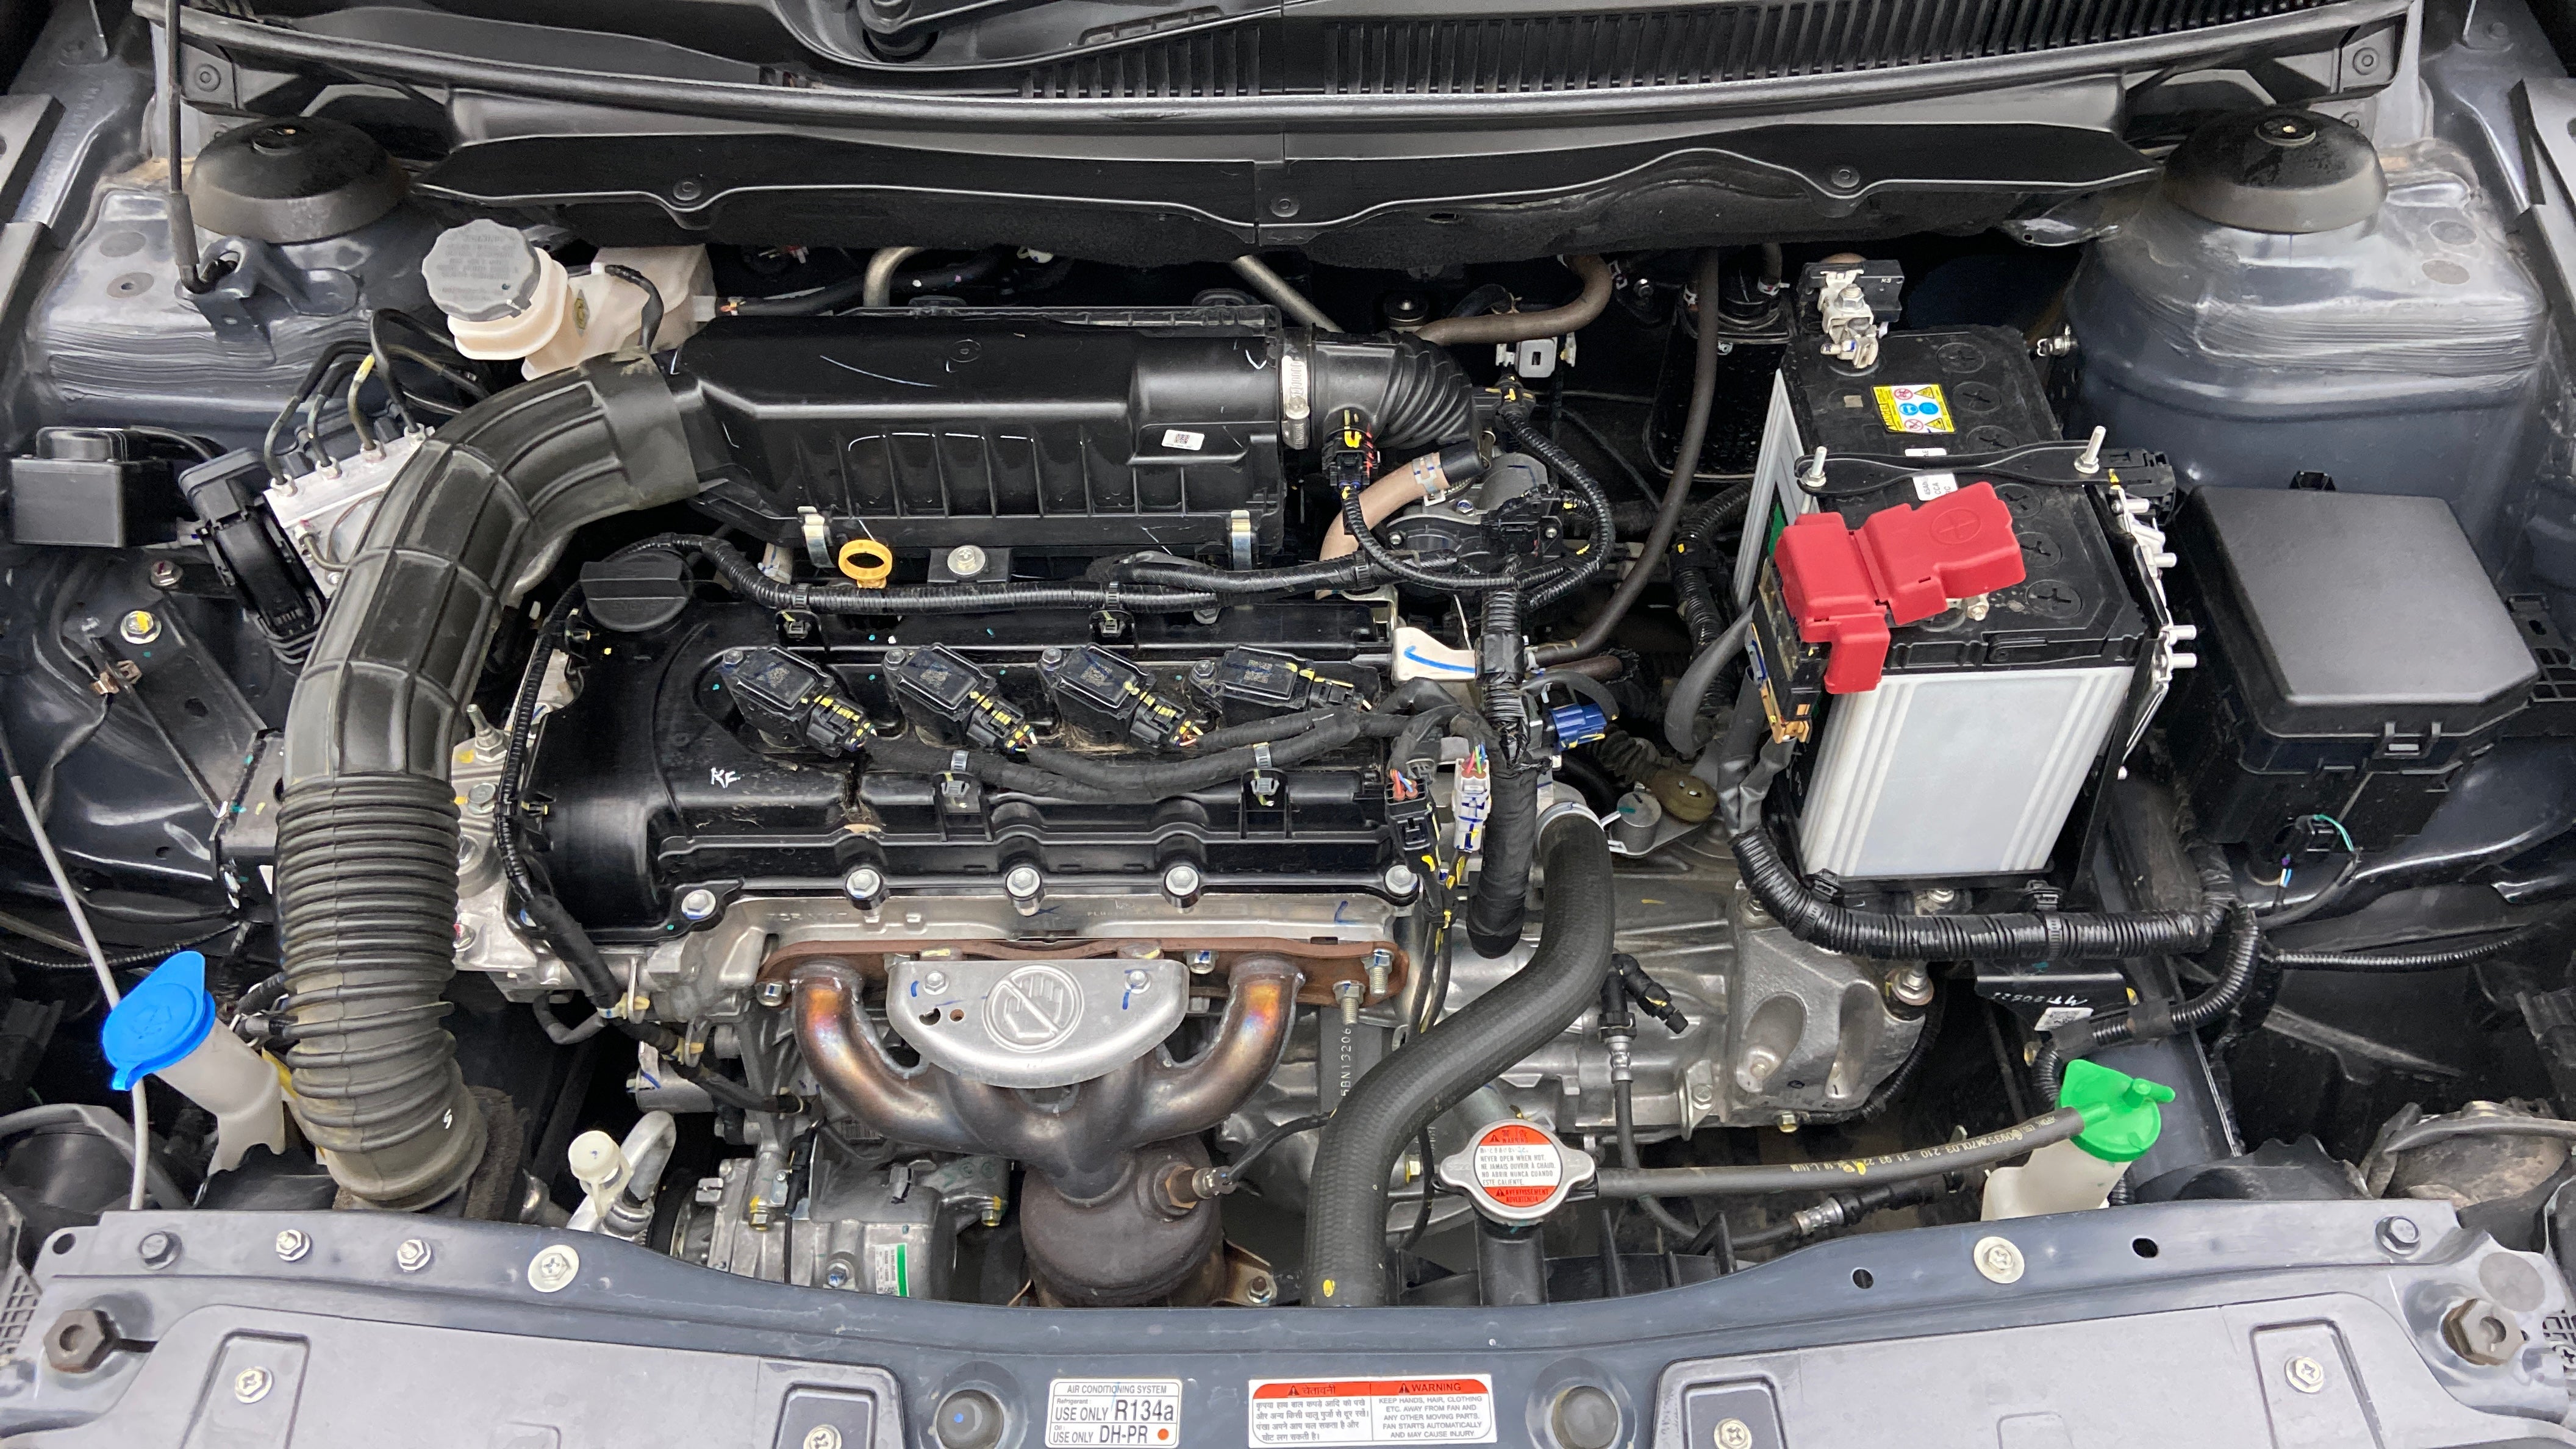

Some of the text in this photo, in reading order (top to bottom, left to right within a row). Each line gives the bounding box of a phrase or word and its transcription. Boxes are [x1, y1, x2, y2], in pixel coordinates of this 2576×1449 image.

[1932, 482, 1941, 495] CCA
[1067, 1385, 1167, 1394] AIR CONDITIONING SYSTEM
[1302, 1384, 1336, 1395] चेतावनी
[1412, 1383, 1461, 1392] WARNING
[1256, 1402, 1273, 1411] कृपया
[1325, 1398, 1340, 1407] आदि
[1055, 1399, 1174, 1422] USE ONLY R134a
[1256, 1411, 1268, 1420] और
[1286, 1409, 1303, 1419] किसी
[1305, 1412, 1319, 1420] चालू
[1336, 1409, 1342, 1418] से
[1343, 1411, 1353, 1420] दूर
[1272, 1421, 1288, 1430] अपने
[1340, 1420, 1345, 1429] है
[1347, 1420, 1359, 1428] और
[1053, 1425, 1148, 1444] USE ONLY DH-PR
[1262, 1433, 1275, 1441] चोट
[1290, 1431, 1309, 1440] सकती
